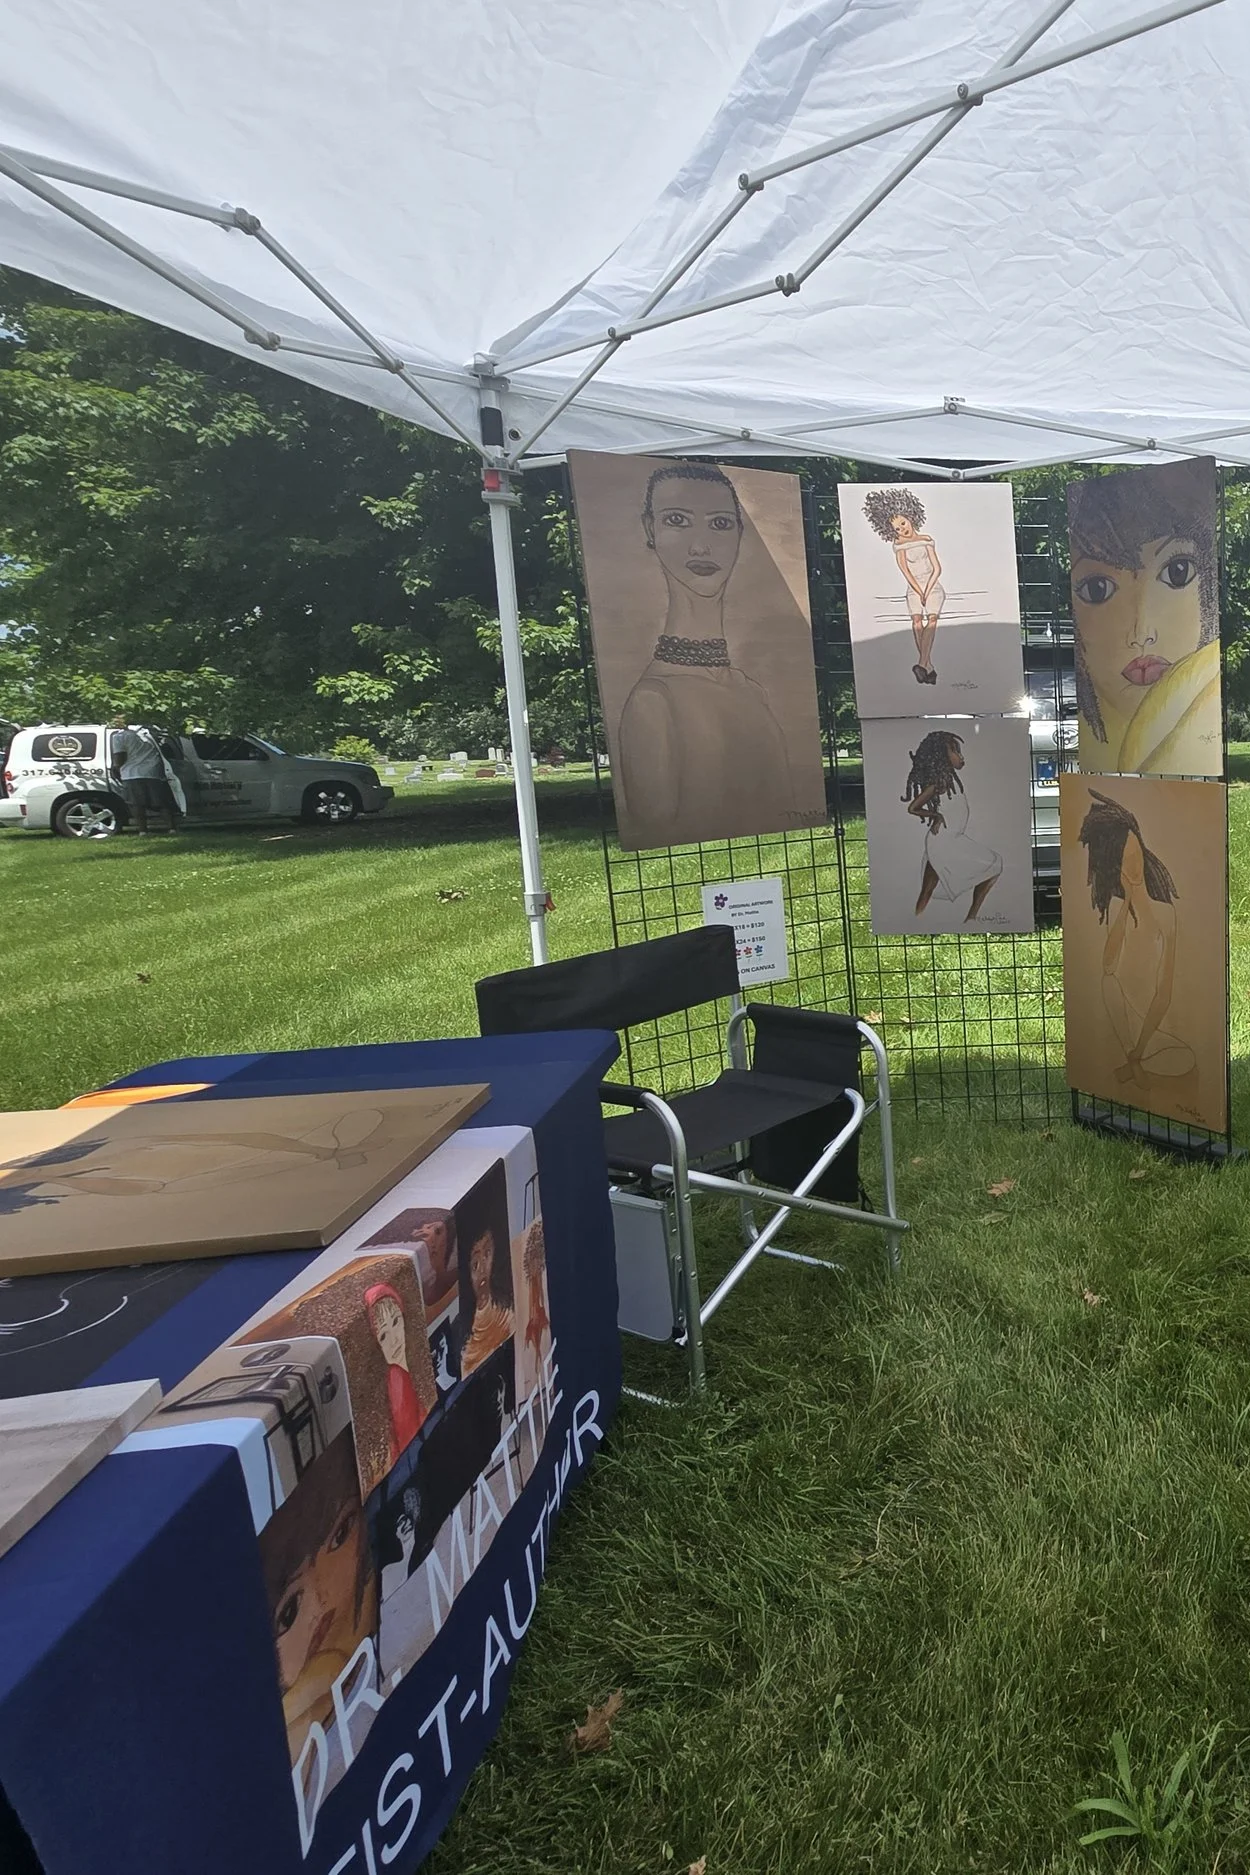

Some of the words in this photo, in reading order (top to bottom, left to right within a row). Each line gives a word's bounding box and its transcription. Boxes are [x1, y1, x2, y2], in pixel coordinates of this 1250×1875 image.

[751, 964, 776, 973] CANVAS
[291, 1634, 402, 1861] DR.
[424, 1337, 564, 1635] MATTIE
